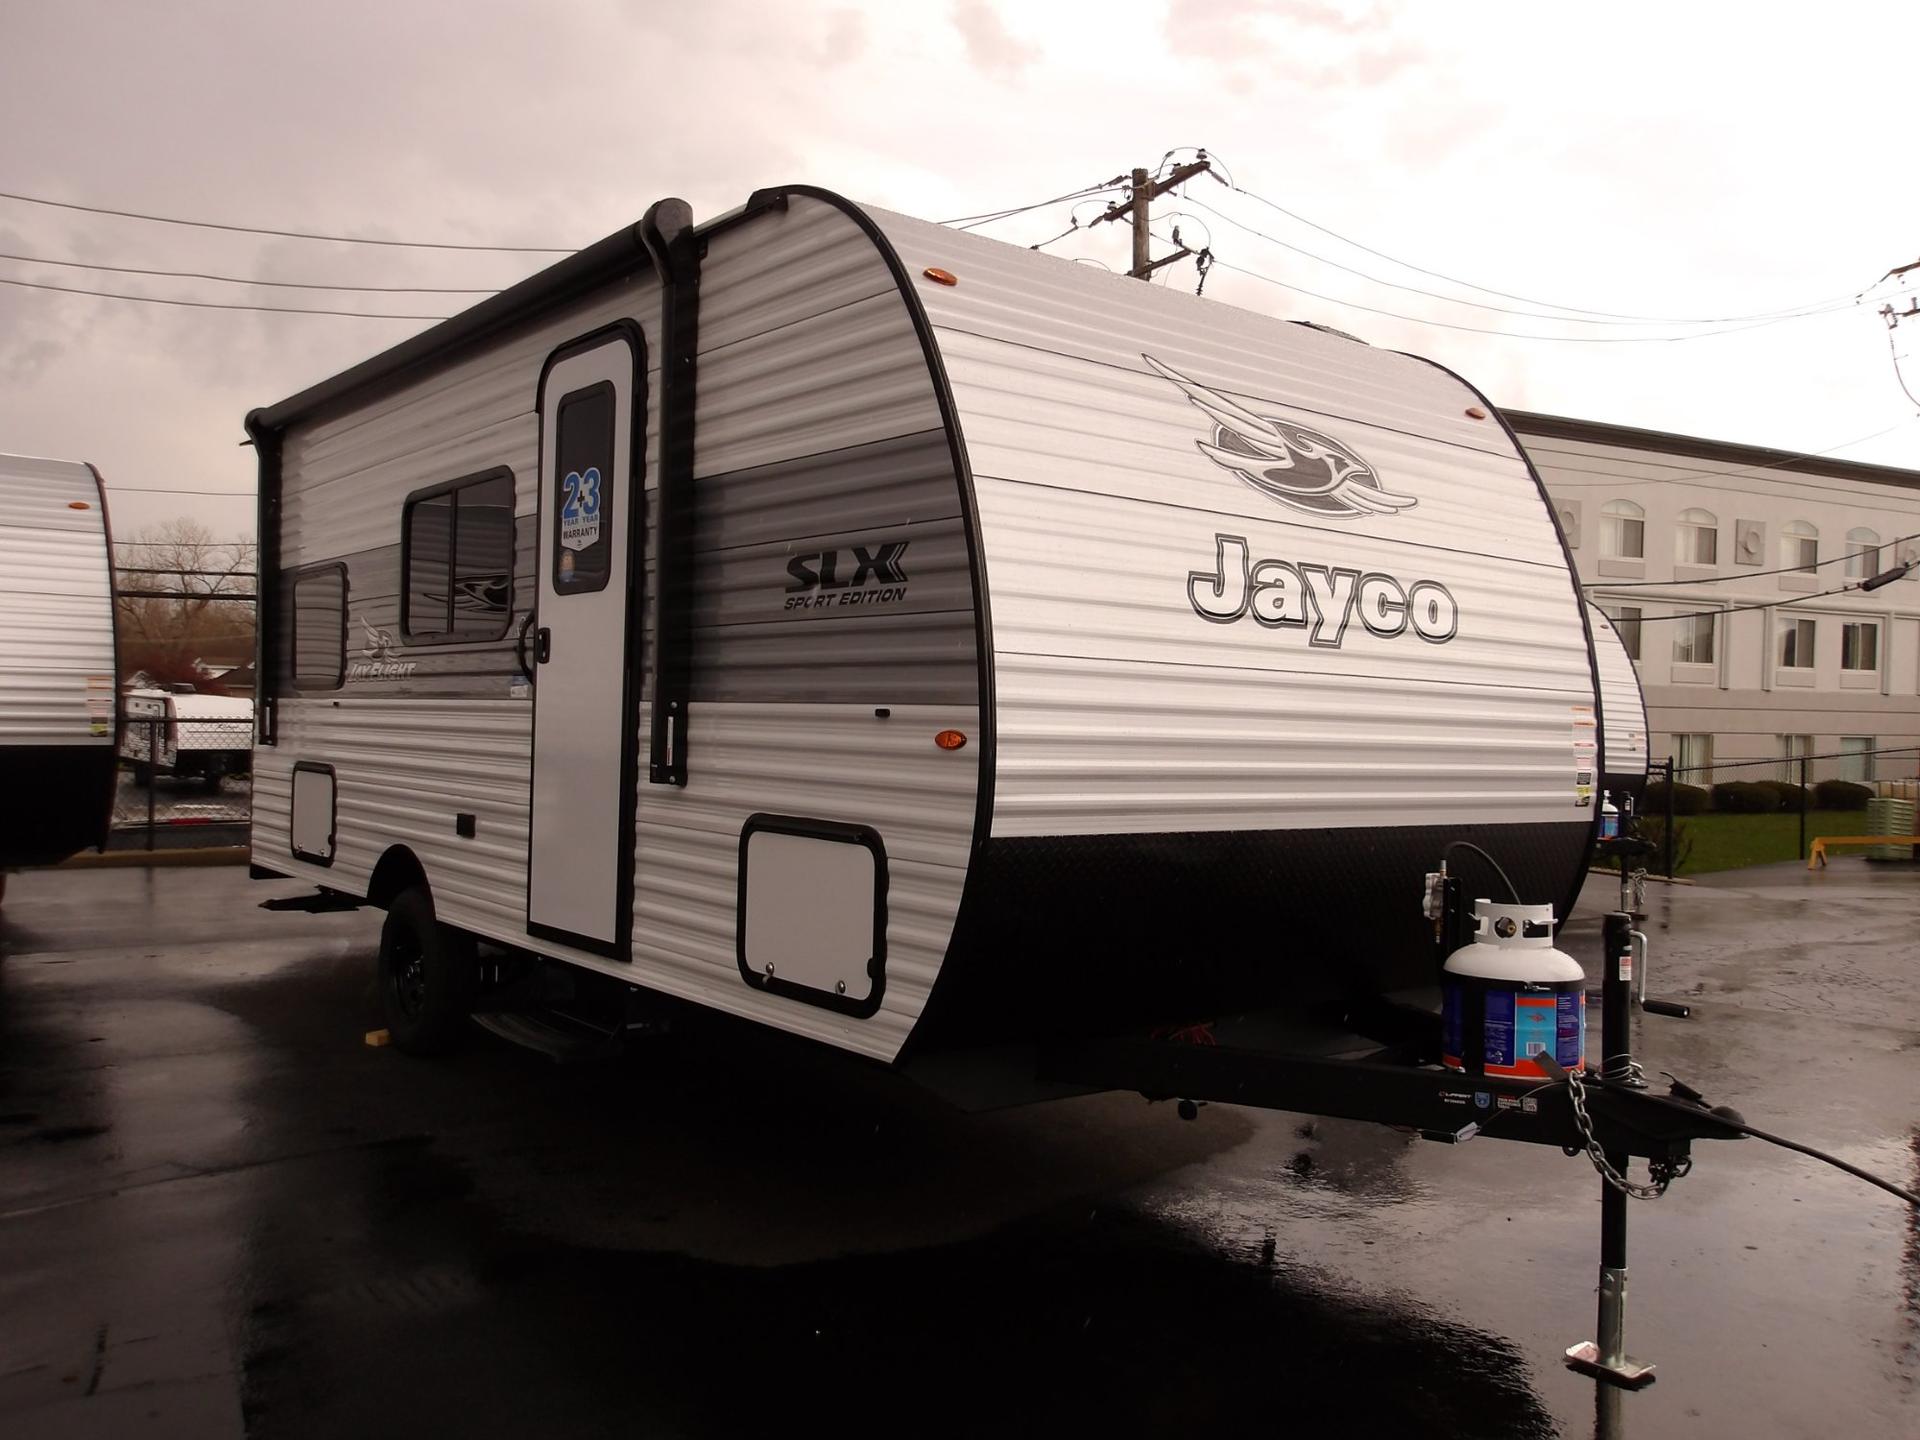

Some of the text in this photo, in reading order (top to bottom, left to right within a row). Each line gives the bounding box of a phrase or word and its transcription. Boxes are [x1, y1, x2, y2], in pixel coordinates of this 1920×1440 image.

[563, 514, 599, 527] YEAR YEAR
[563, 526, 598, 540] WARRANTY
[785, 541, 910, 593] SLX
[784, 587, 907, 610] SPORT EDITION
[1187, 533, 1458, 649] Jayco
